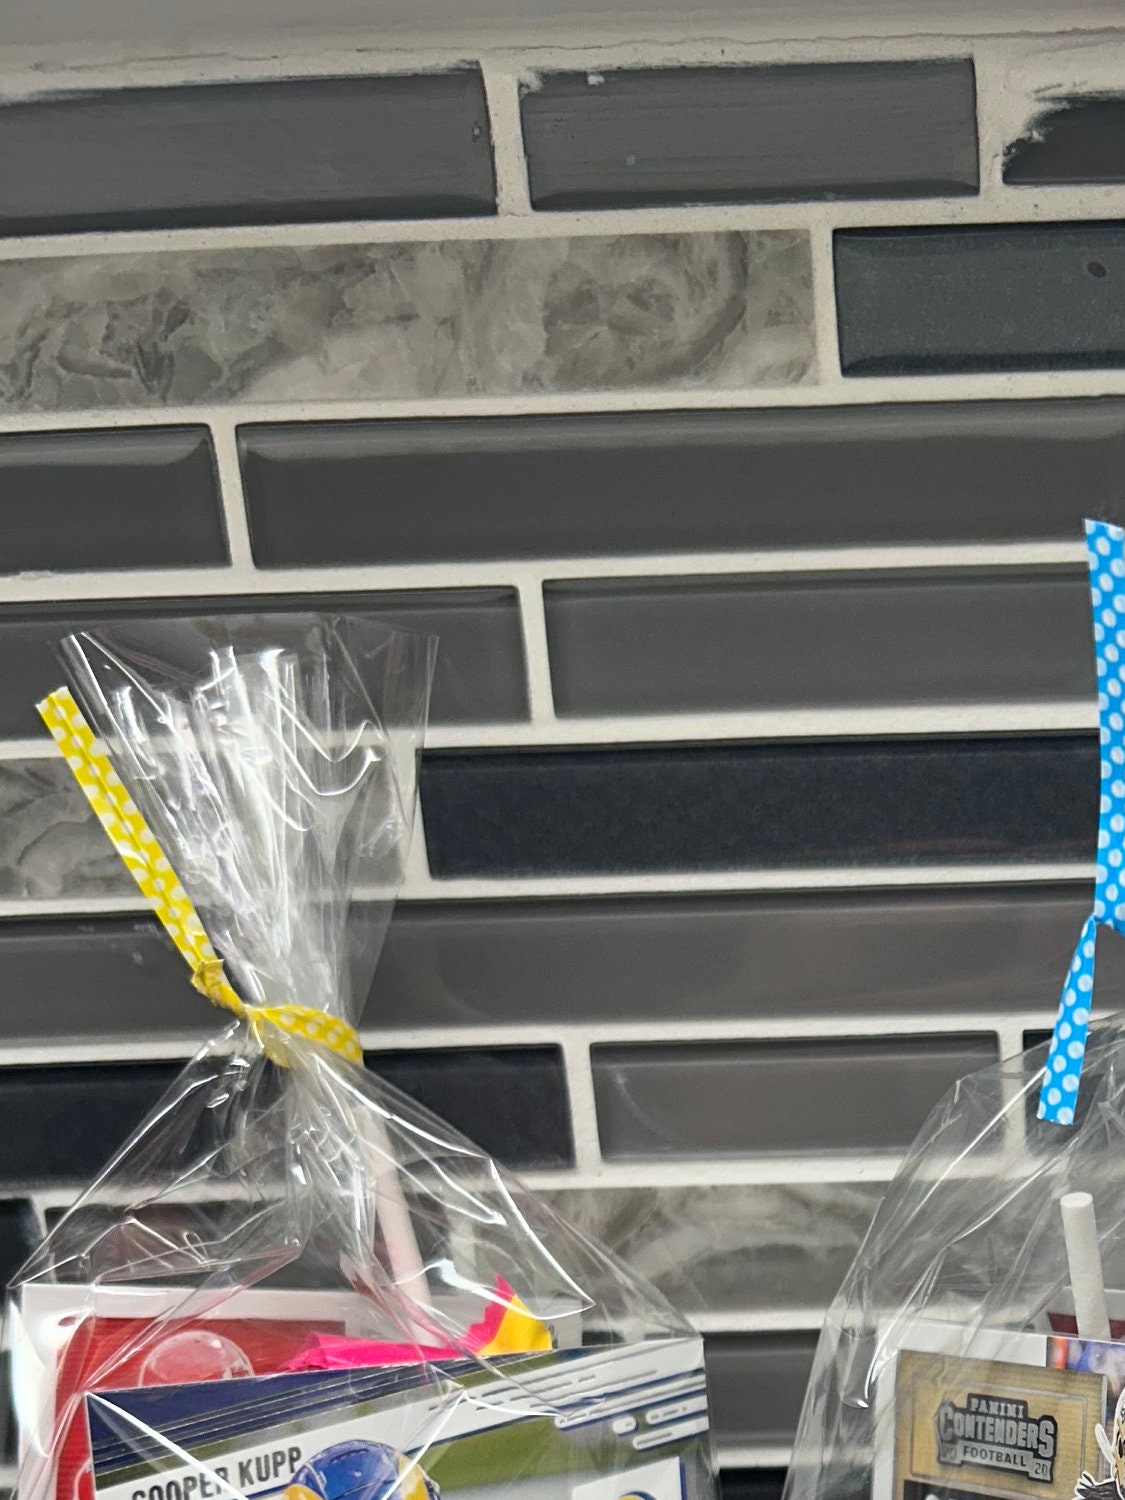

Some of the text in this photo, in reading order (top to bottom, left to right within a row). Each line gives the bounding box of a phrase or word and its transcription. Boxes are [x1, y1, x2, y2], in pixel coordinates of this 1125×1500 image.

[970, 1398, 1025, 1419] PANINI
[939, 1405, 1056, 1459] CONTENDERS
[238, 1446, 302, 1488] KUPP
[962, 1446, 1027, 1467] FOOTBALL
[1034, 1463, 1048, 1476] 20
